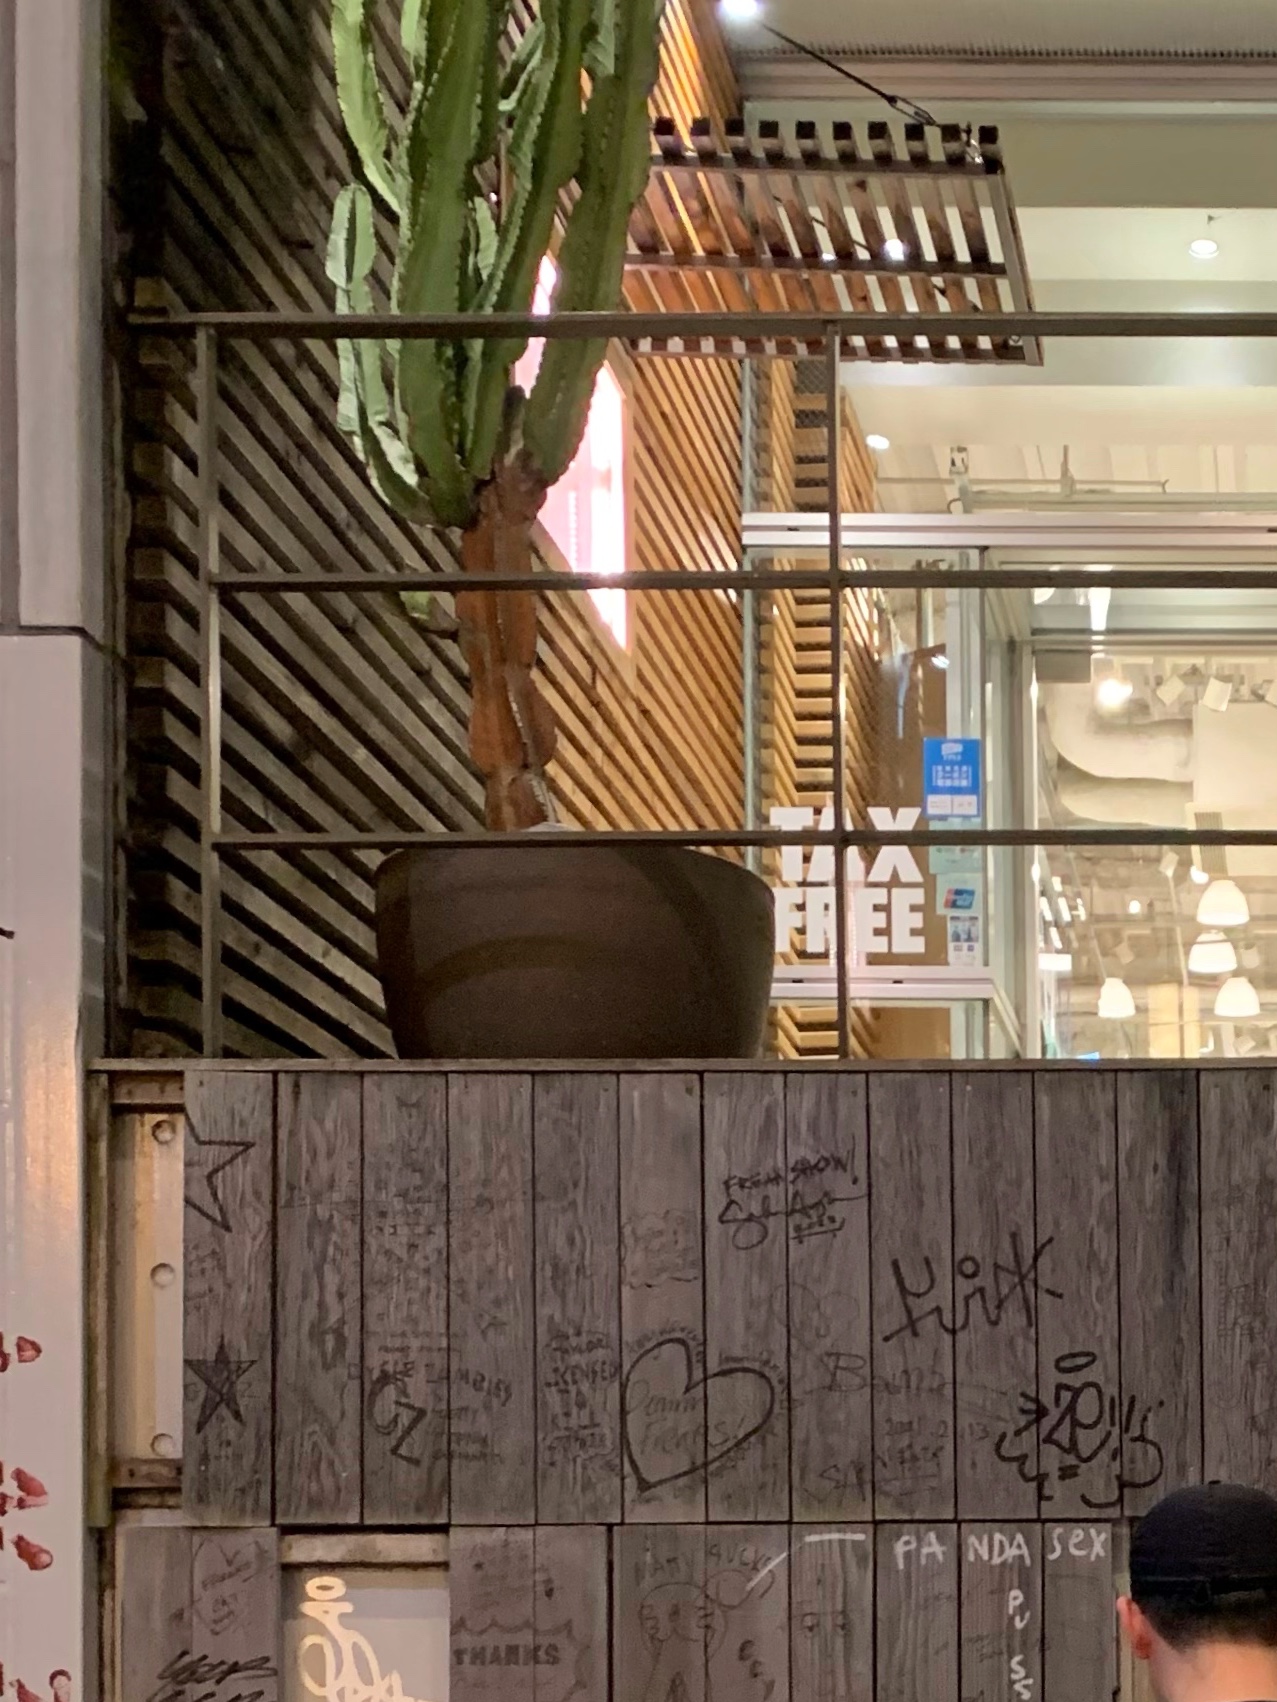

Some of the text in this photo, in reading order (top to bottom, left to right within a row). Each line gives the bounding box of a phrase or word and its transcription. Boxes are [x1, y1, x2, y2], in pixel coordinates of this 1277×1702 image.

[770, 807, 923, 883] TAX
[774, 887, 926, 954] FREE
[453, 1642, 562, 1667] THANKS
